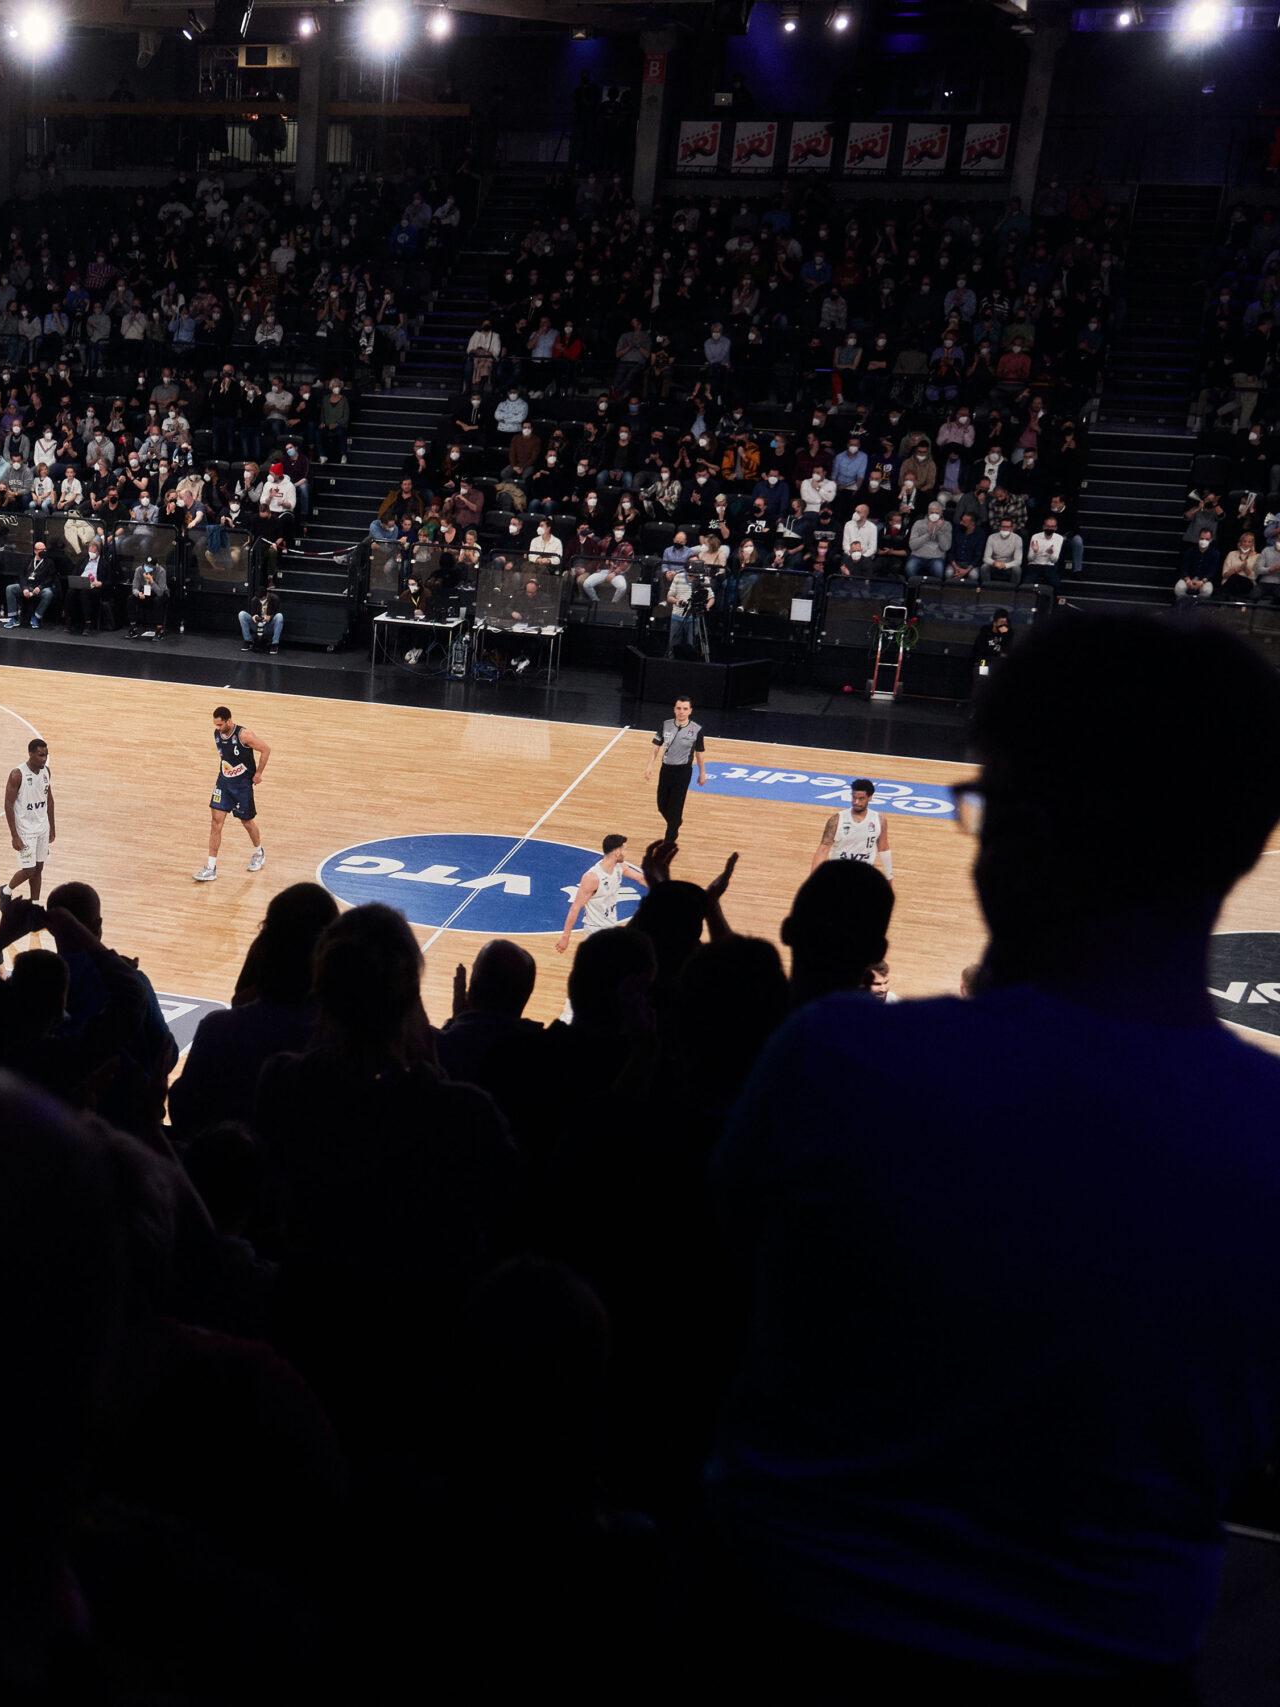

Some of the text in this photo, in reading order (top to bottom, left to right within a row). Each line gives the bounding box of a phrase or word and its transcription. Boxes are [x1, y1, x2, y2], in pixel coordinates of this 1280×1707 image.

[234, 746, 239, 755] 6
[866, 836, 876, 848] 15
[334, 856, 530, 895] VTG
